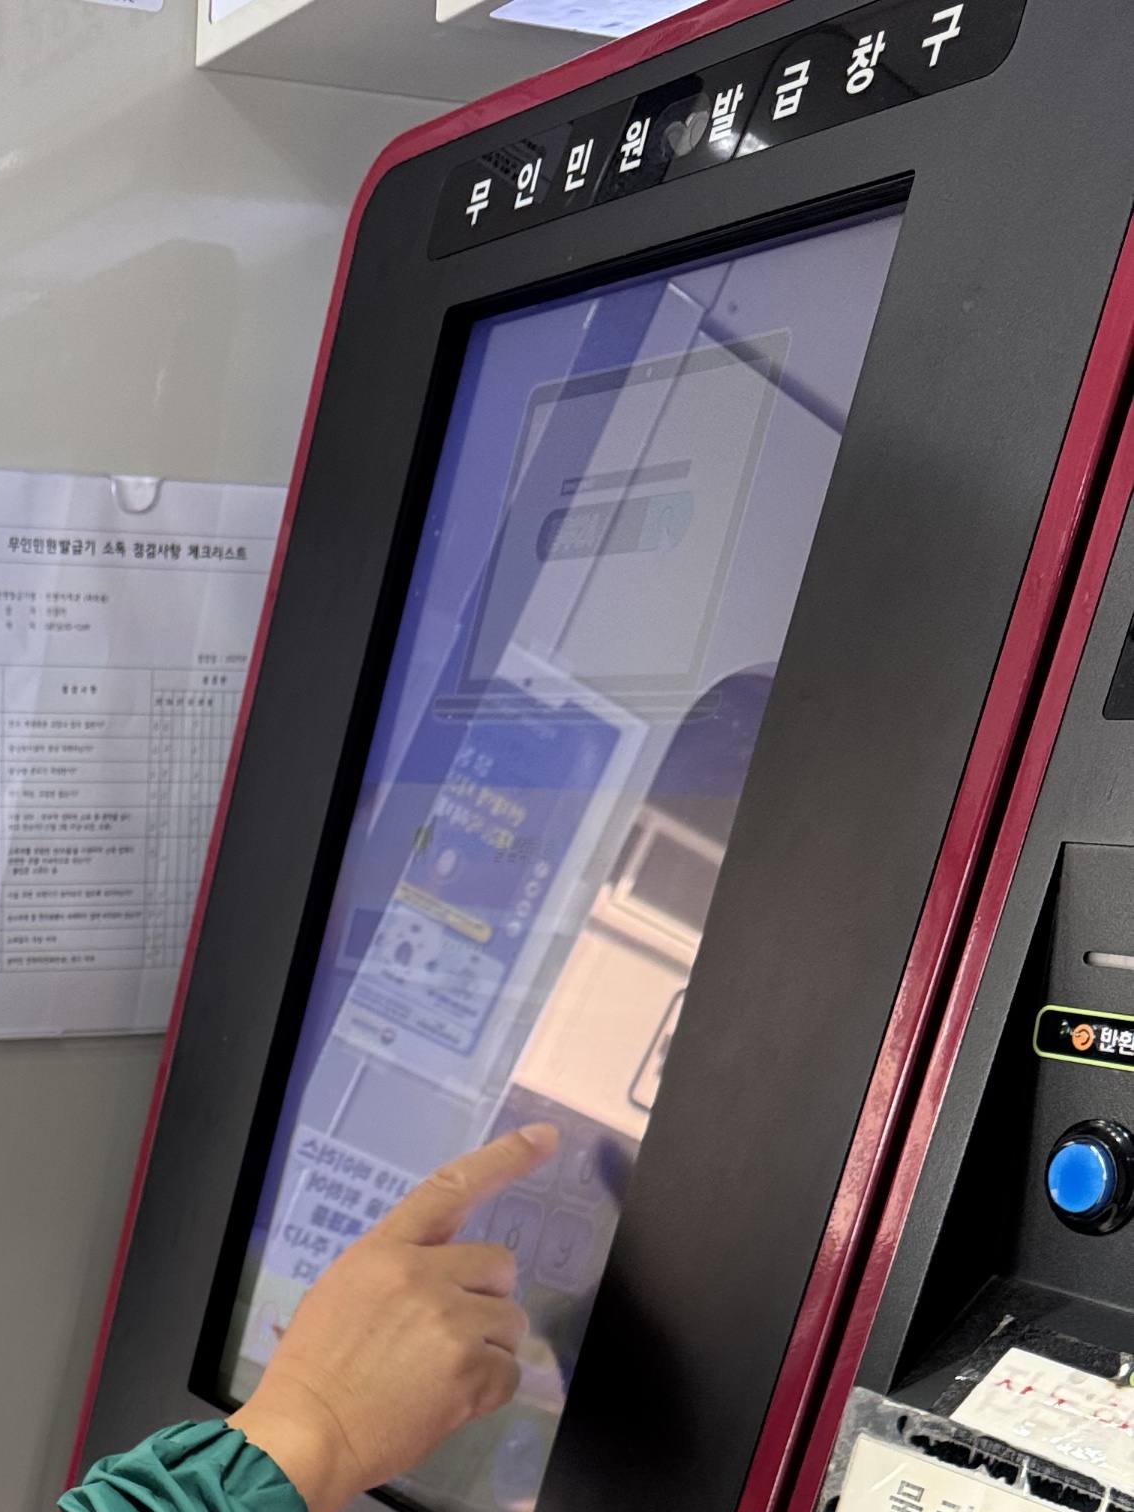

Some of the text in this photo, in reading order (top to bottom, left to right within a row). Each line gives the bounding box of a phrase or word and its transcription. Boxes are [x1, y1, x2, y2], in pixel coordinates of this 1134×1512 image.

[466, 3, 964, 226] 무인민원발급창구
[7, 535, 97, 557] 무인민원발급기
[188, 545, 248, 562] 체크리스트
